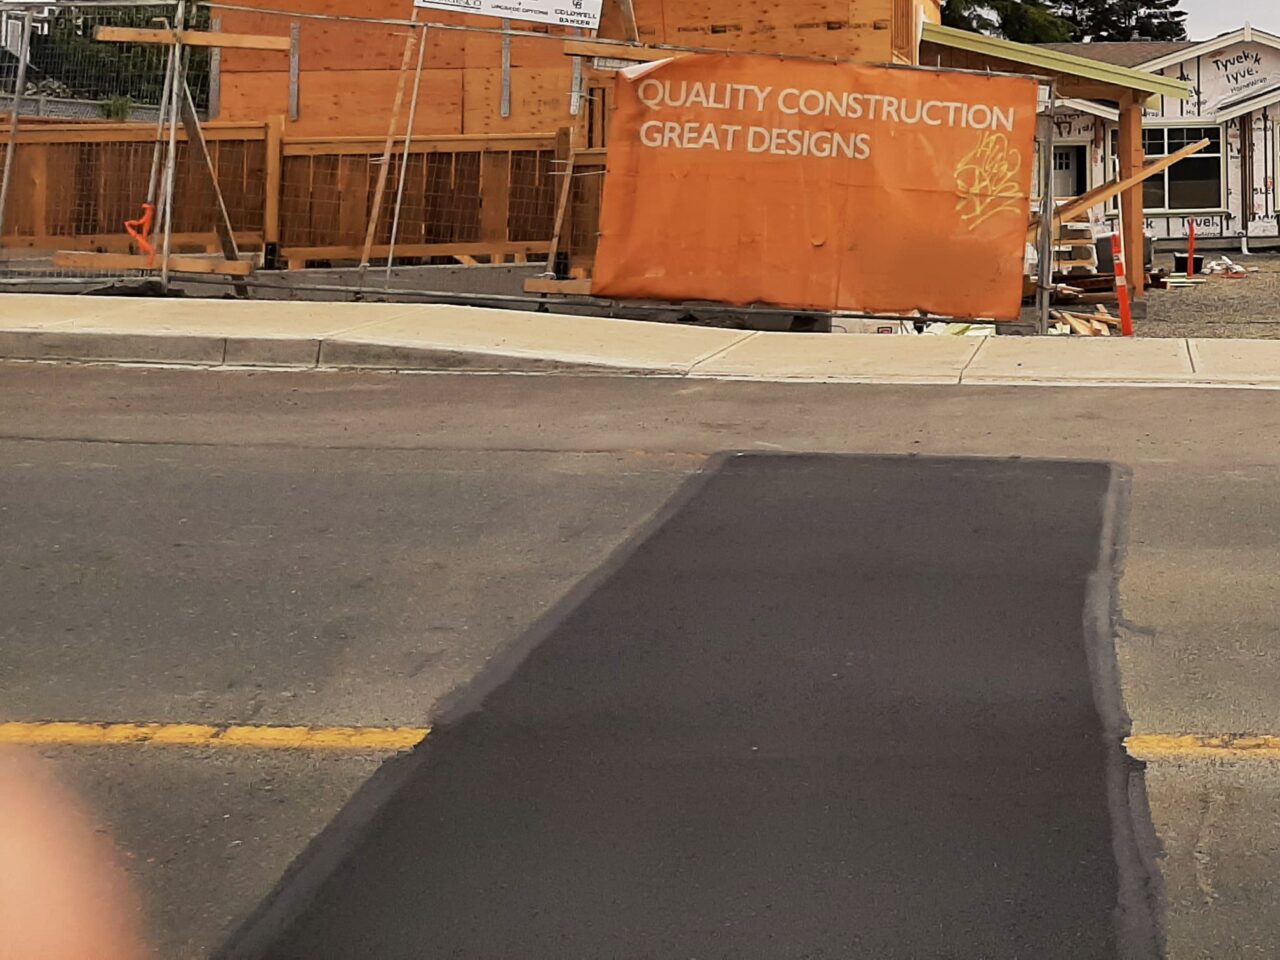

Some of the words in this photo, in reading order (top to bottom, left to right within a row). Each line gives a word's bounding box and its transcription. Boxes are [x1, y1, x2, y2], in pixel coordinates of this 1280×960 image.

[554, 8, 598, 19] COLDWELL
[1213, 50, 1252, 71] Tyvek
[638, 78, 773, 112] QUALITY
[777, 87, 1015, 132] CONSTRUCTION
[640, 120, 742, 152] GREAT
[747, 126, 872, 161] DESIGNS
